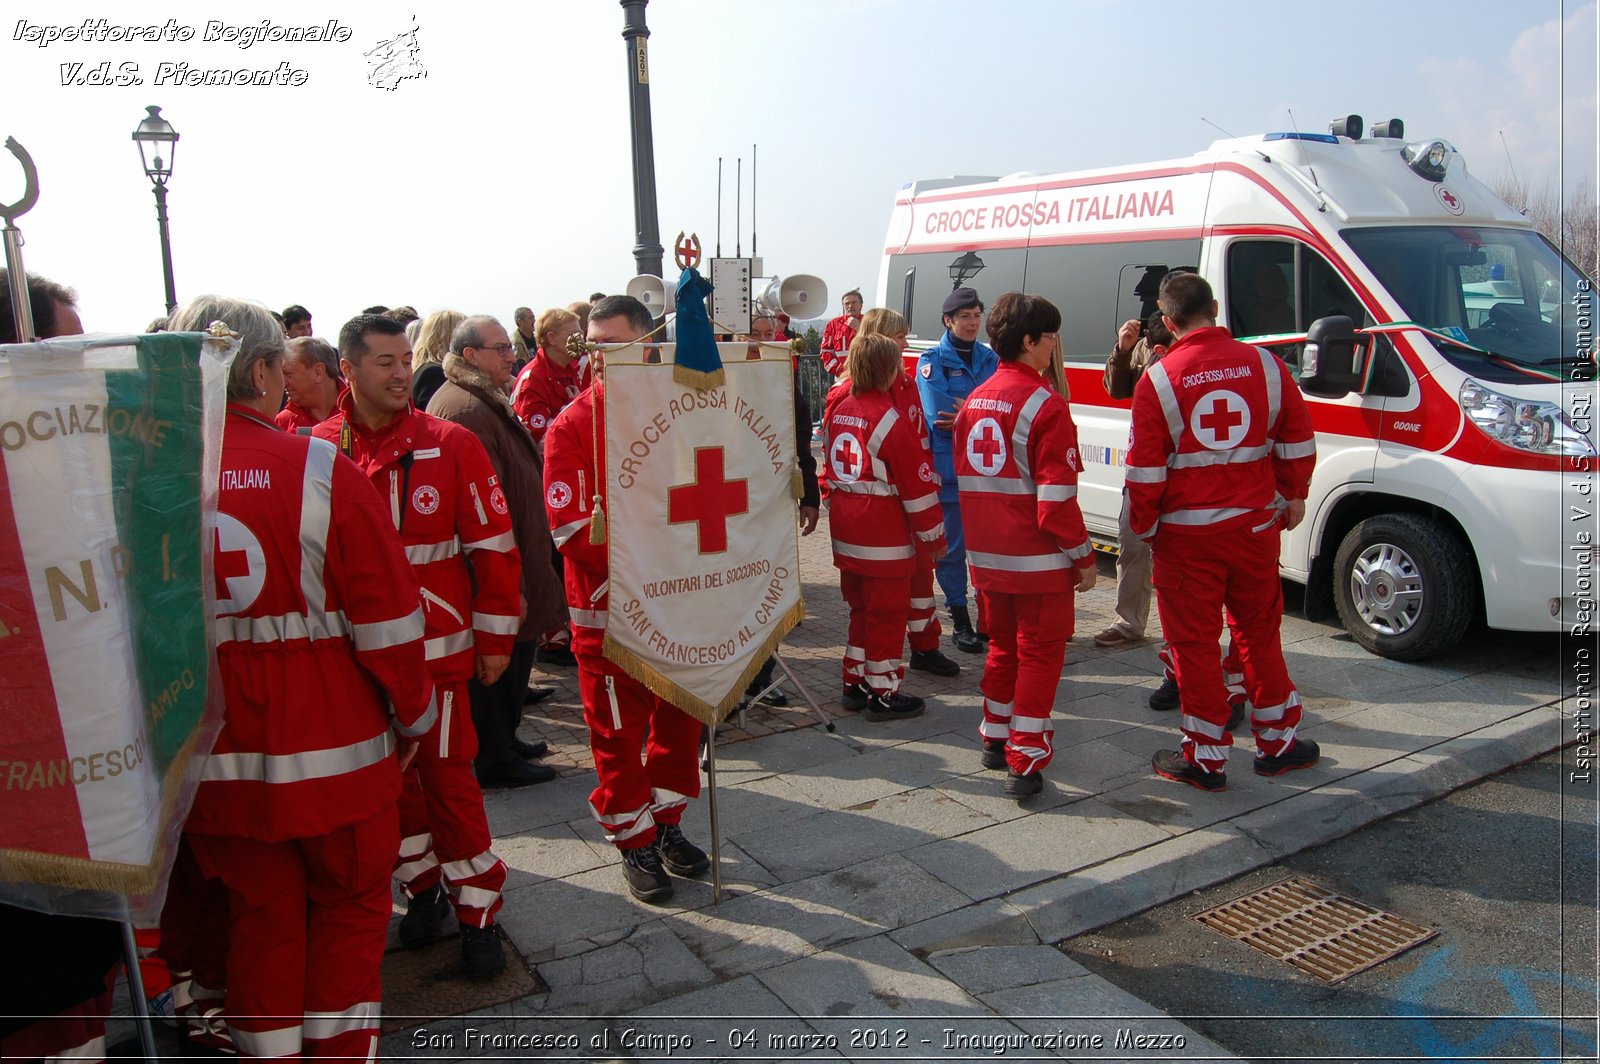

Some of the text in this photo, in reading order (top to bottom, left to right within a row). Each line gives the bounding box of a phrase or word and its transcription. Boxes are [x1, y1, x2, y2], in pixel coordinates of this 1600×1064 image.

[925, 189, 1174, 234] CROCE ROSSA ITALIANA
[1182, 365, 1252, 388] CROCE ROSSA ITALIANA
[618, 388, 784, 490] CROCE ROSSA ITALIANA
[1393, 421, 1421, 433] ODONE
[222, 469, 271, 491] ITALIANA
[643, 558, 771, 599] VOLONTARI DEL SOCCORSO
[623, 566, 789, 665] SAN FRANCESCO AL CAMPO
